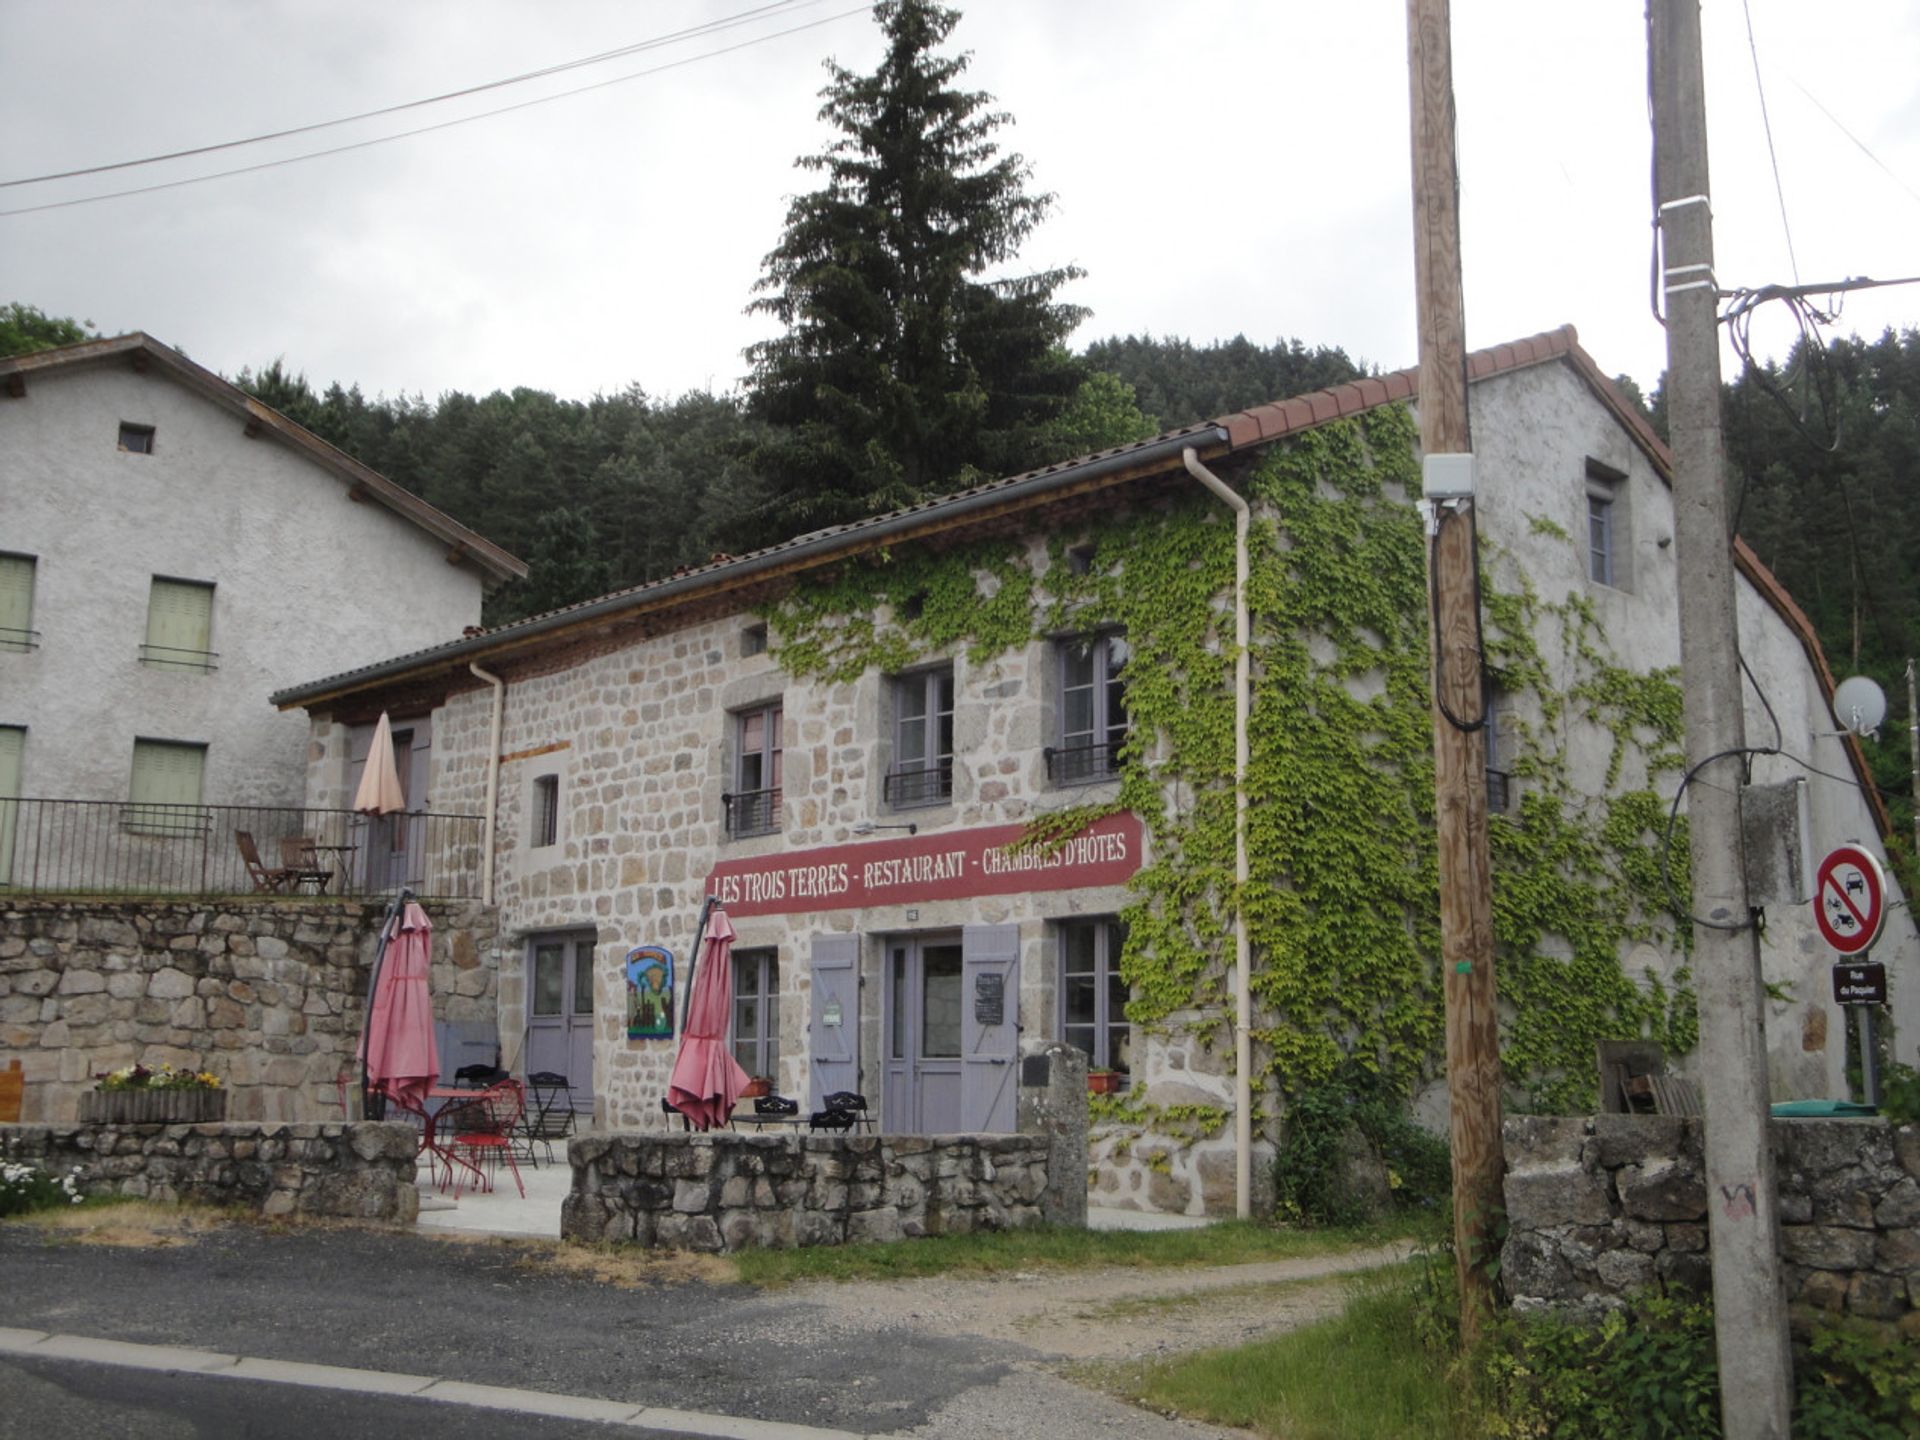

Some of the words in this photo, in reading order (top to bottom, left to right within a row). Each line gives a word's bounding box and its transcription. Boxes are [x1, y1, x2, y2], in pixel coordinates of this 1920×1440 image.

[714, 875, 740, 904] LES
[743, 870, 785, 903] TROIS
[788, 863, 848, 898] TERRES
[864, 851, 966, 889] RESTAURANT
[983, 841, 1062, 874] CHAMBRES
[1065, 829, 1126, 865] D'HÔTES
[1850, 970, 1864, 980] Rue
